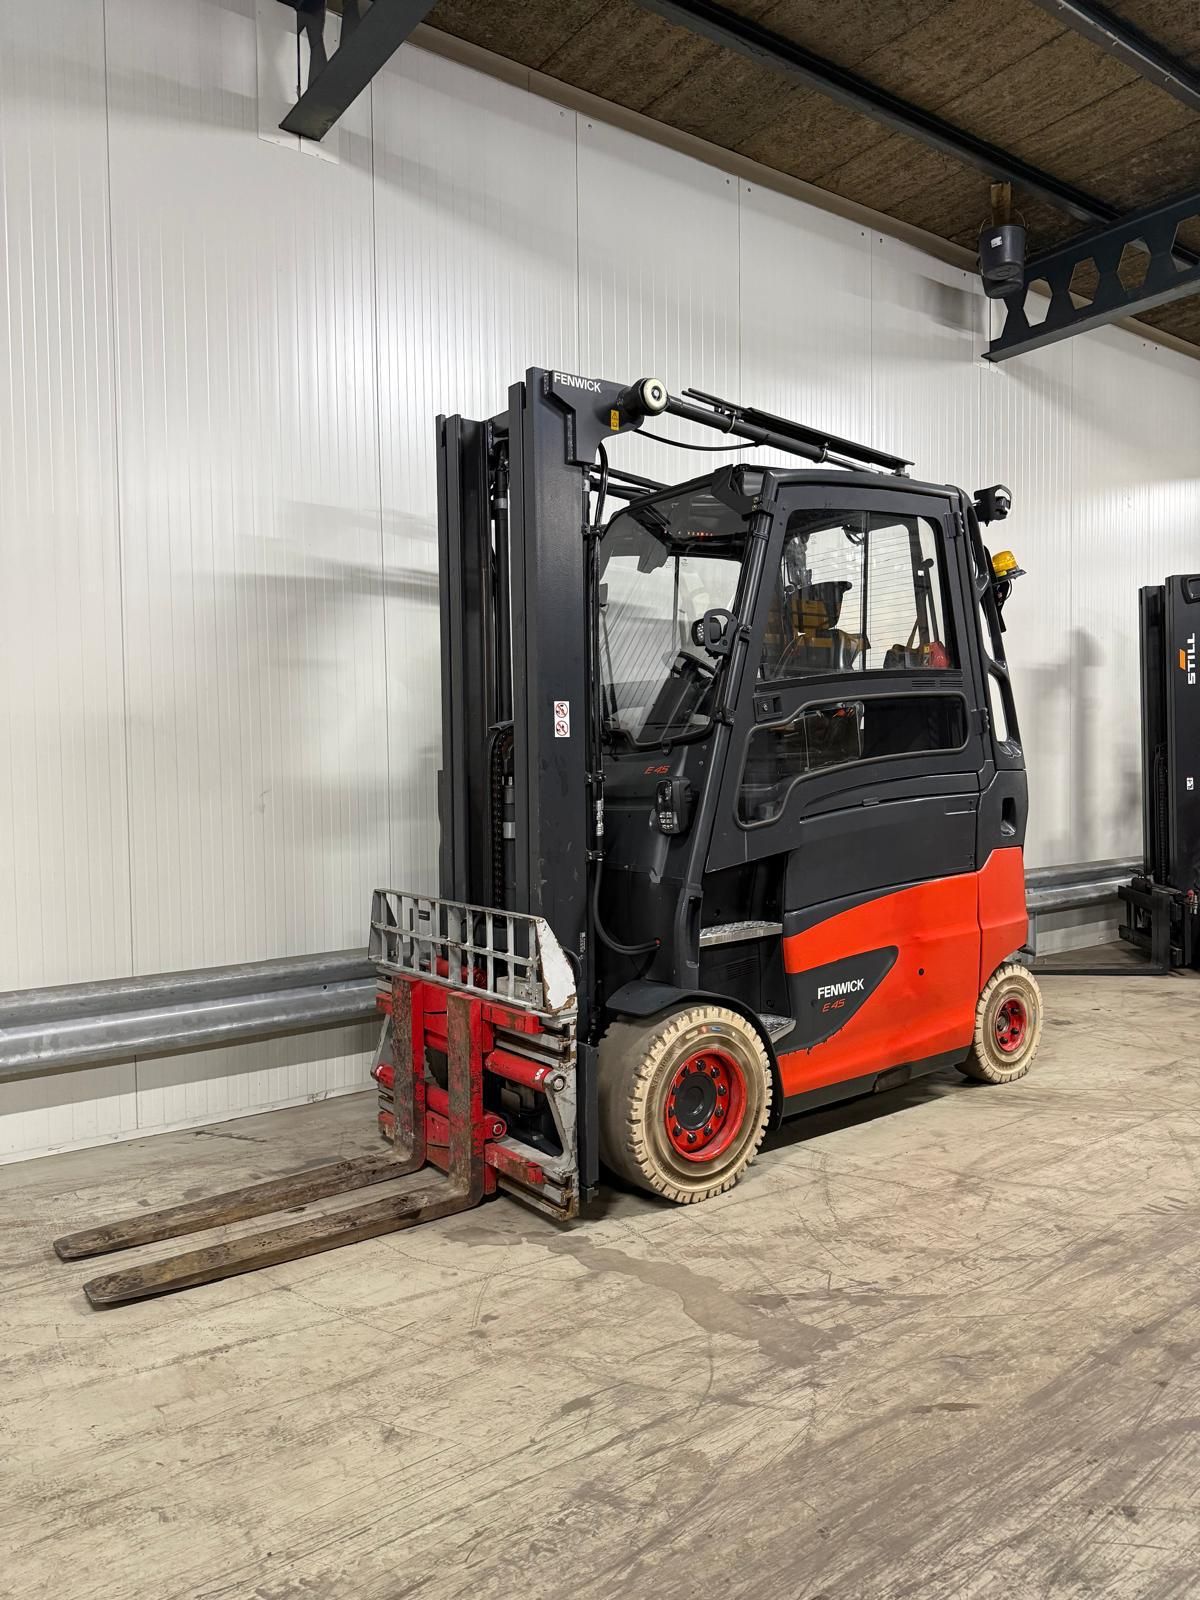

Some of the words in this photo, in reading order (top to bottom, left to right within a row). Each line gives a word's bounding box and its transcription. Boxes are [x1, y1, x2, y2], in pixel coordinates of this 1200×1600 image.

[553, 372, 602, 393] FENWICK
[1187, 632, 1196, 685] STILL
[817, 978, 864, 1000] FENWICK
